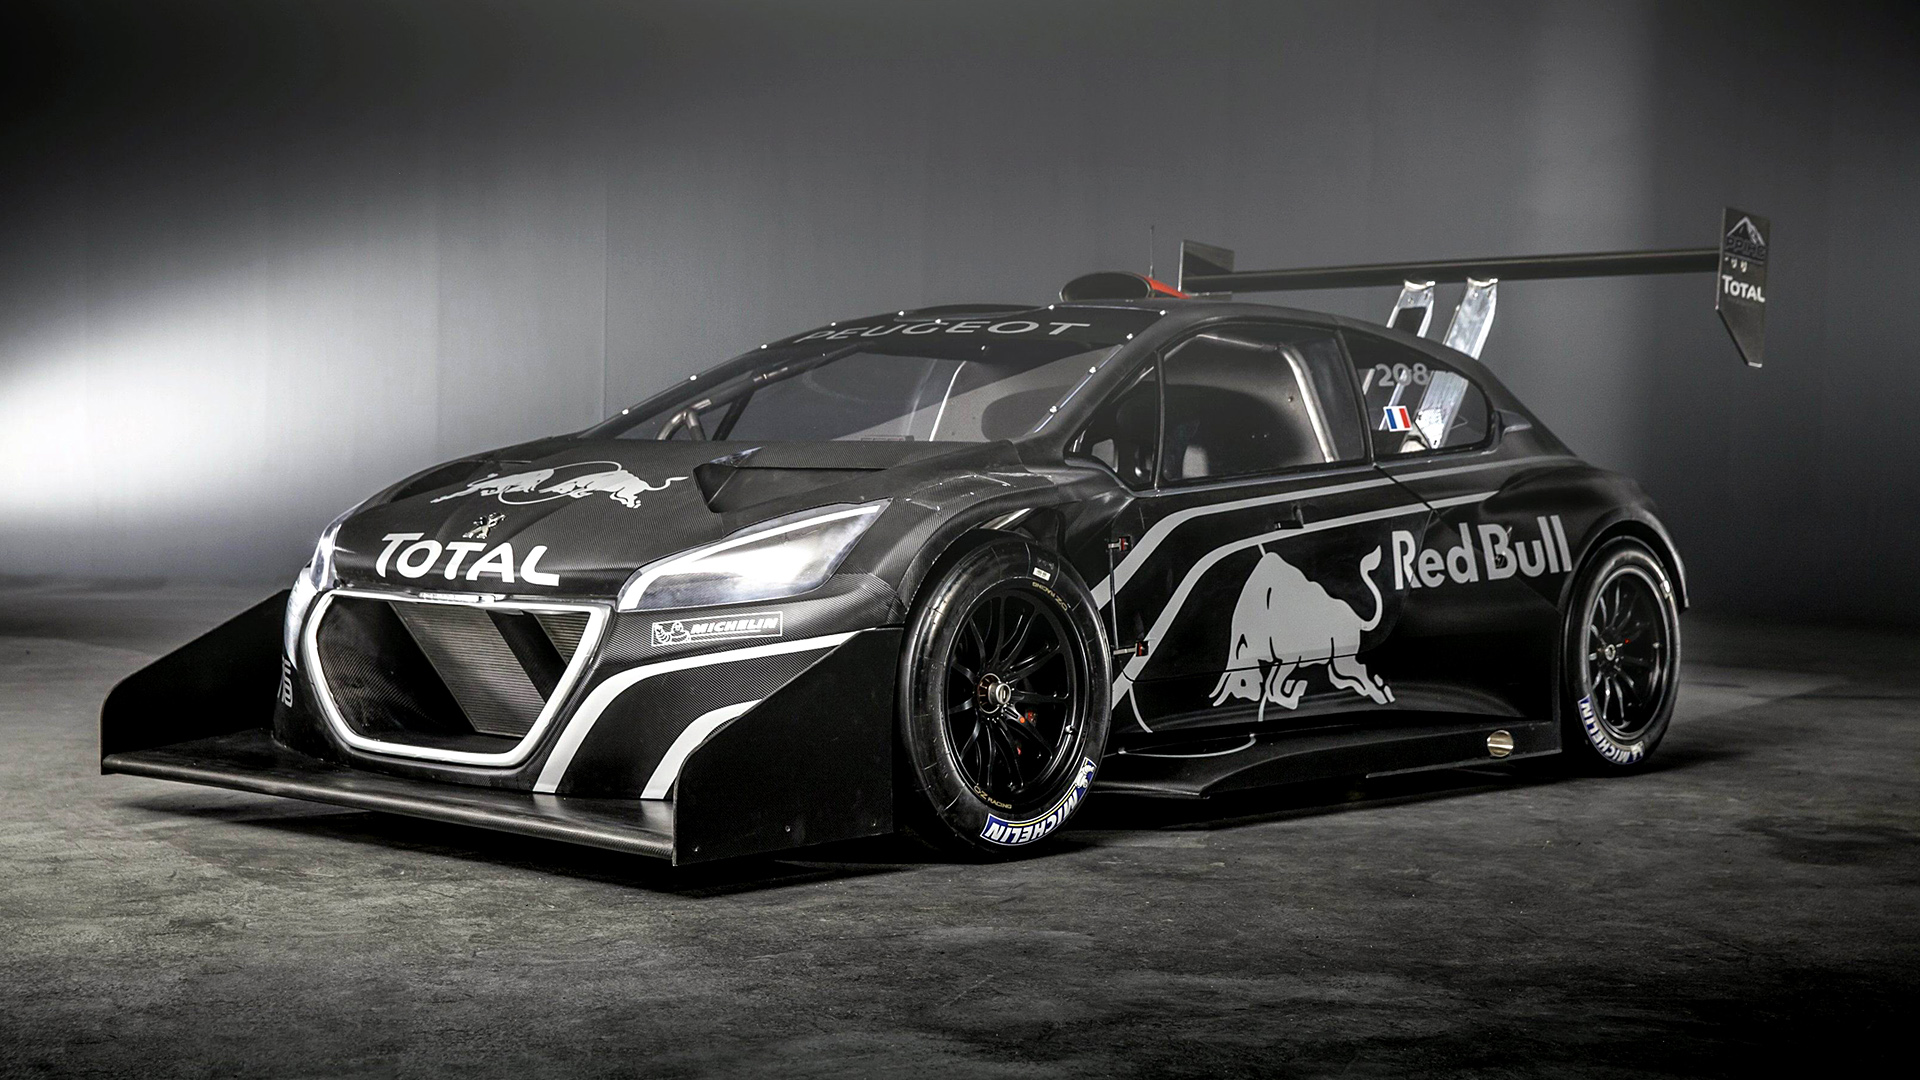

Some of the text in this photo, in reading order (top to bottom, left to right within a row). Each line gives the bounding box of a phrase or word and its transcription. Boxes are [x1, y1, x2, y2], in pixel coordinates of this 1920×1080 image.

[1722, 274, 1766, 303] TOTAL
[793, 320, 1090, 343] PEUGEOT
[1375, 363, 1429, 387] 208
[375, 532, 560, 587] TOTAL
[1392, 515, 1573, 590] Red Bull
[690, 617, 779, 635] MICHELIN
[1580, 703, 1631, 763] MICHELIN
[973, 785, 989, 801] OZ
[985, 795, 1079, 844] MICHELIN
